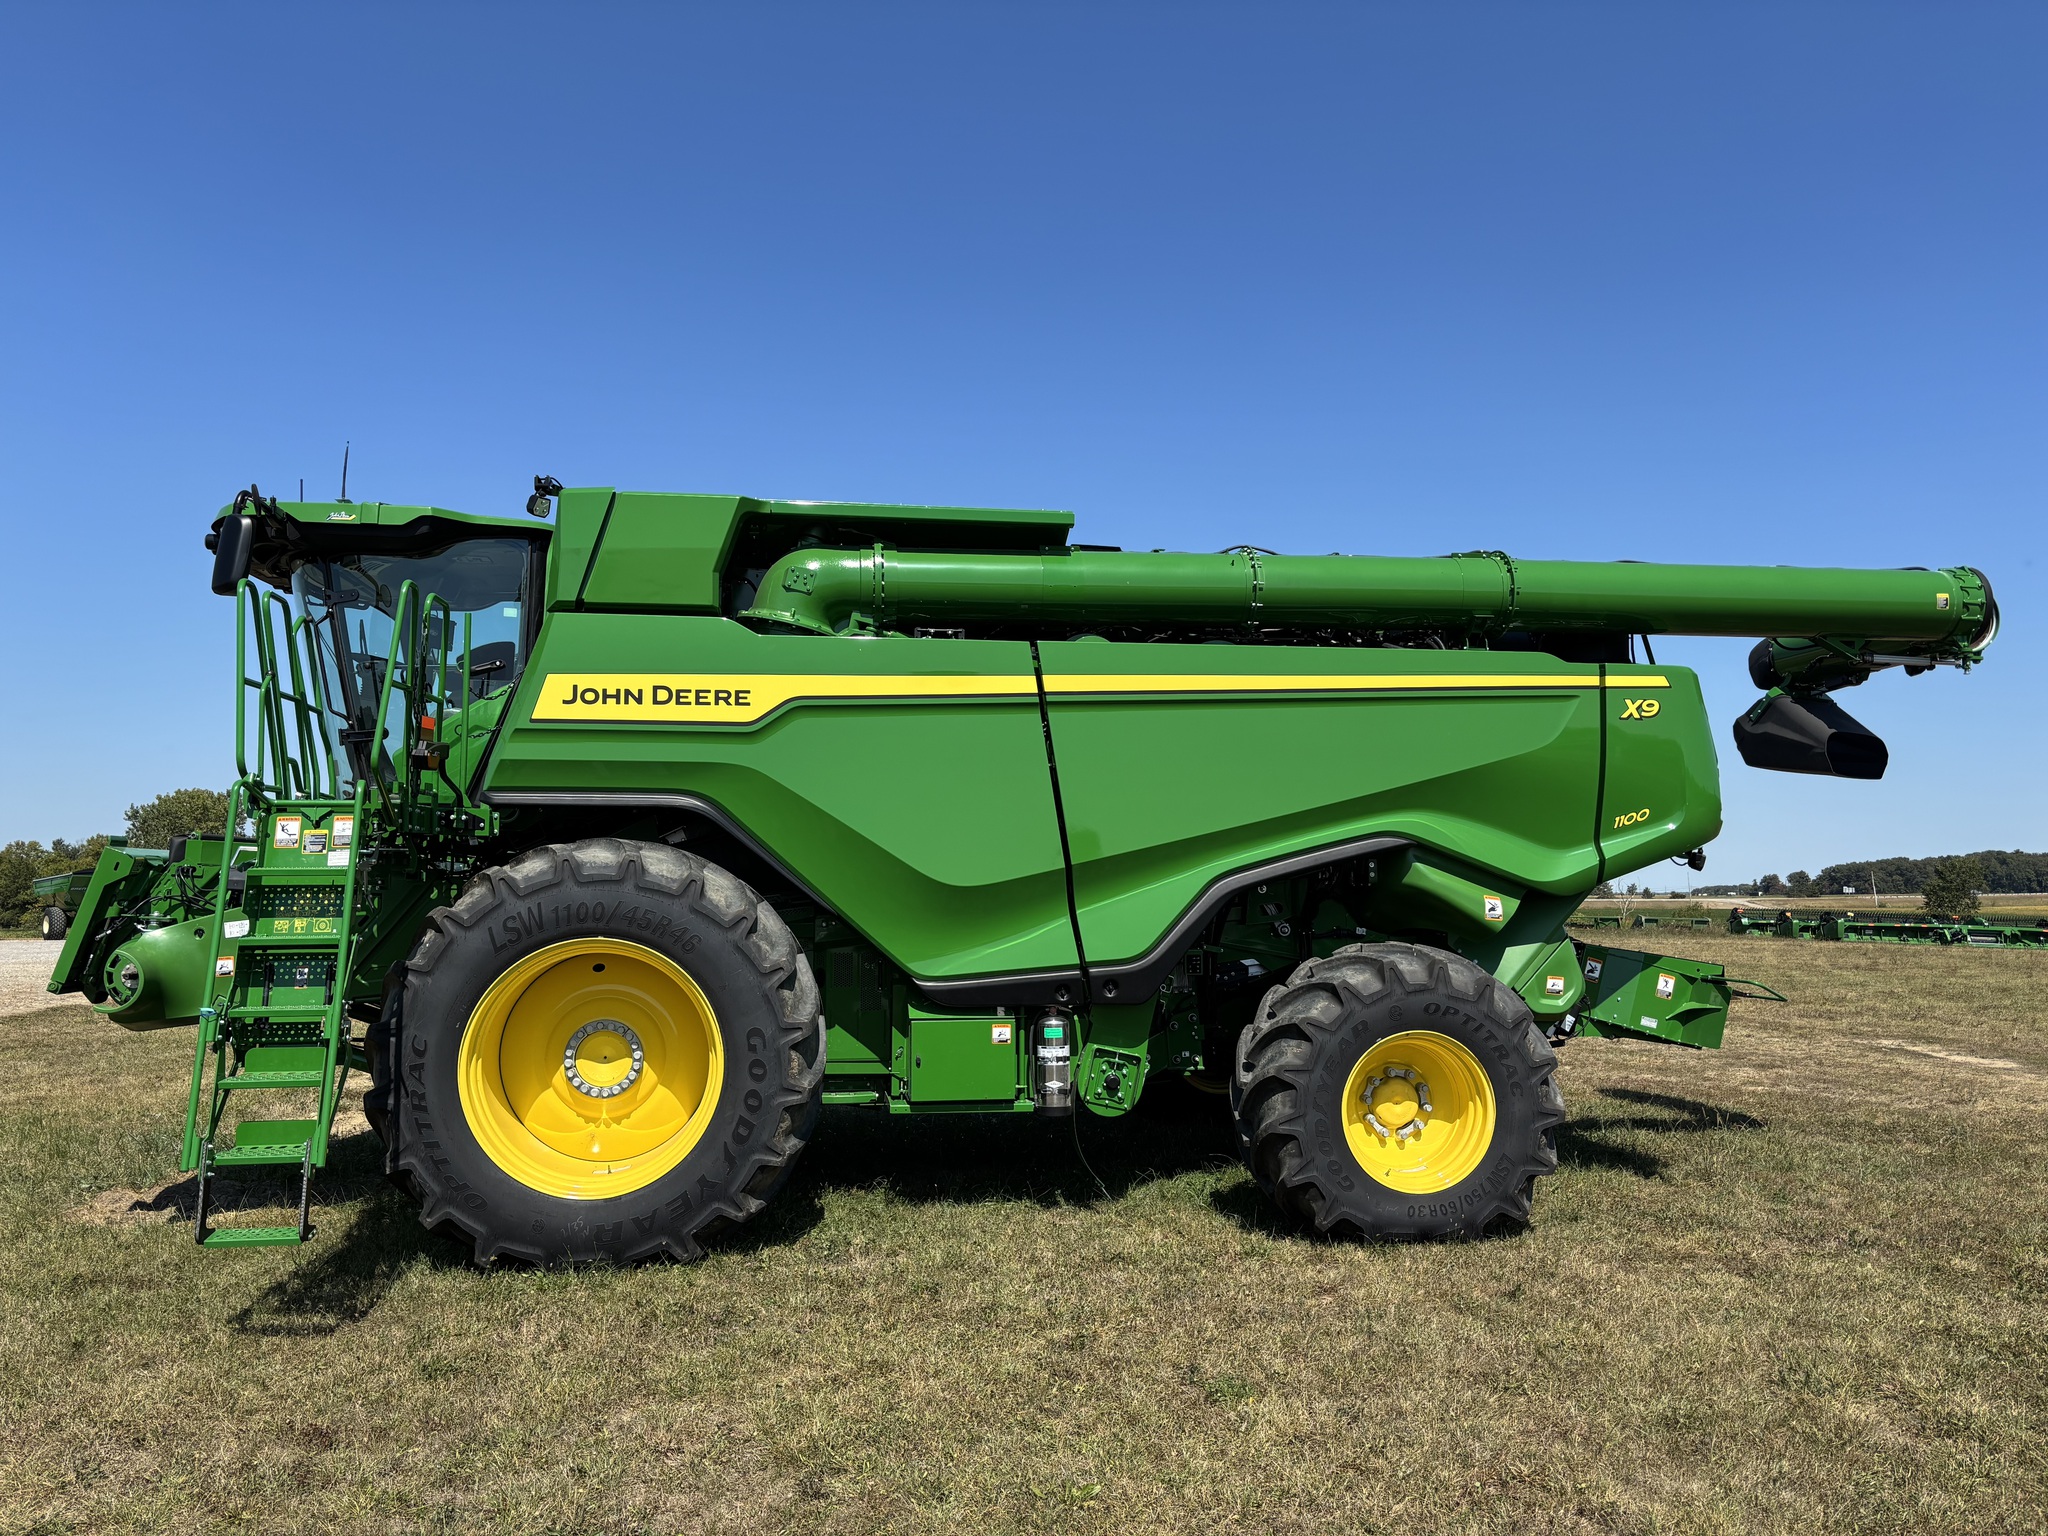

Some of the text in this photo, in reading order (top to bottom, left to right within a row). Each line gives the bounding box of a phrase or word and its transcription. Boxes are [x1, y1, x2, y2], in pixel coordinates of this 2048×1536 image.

[562, 684, 751, 707] JOHN DEERE
[1618, 698, 1661, 721] X9
[1613, 808, 1650, 829] 1100
[487, 900, 704, 957] LSW 1100/45R46
[1422, 1002, 1524, 1098] OPTITRAC
[408, 1034, 488, 1213] OPTITRAC
[1407, 1152, 1517, 1218] LSW 750/60R30
